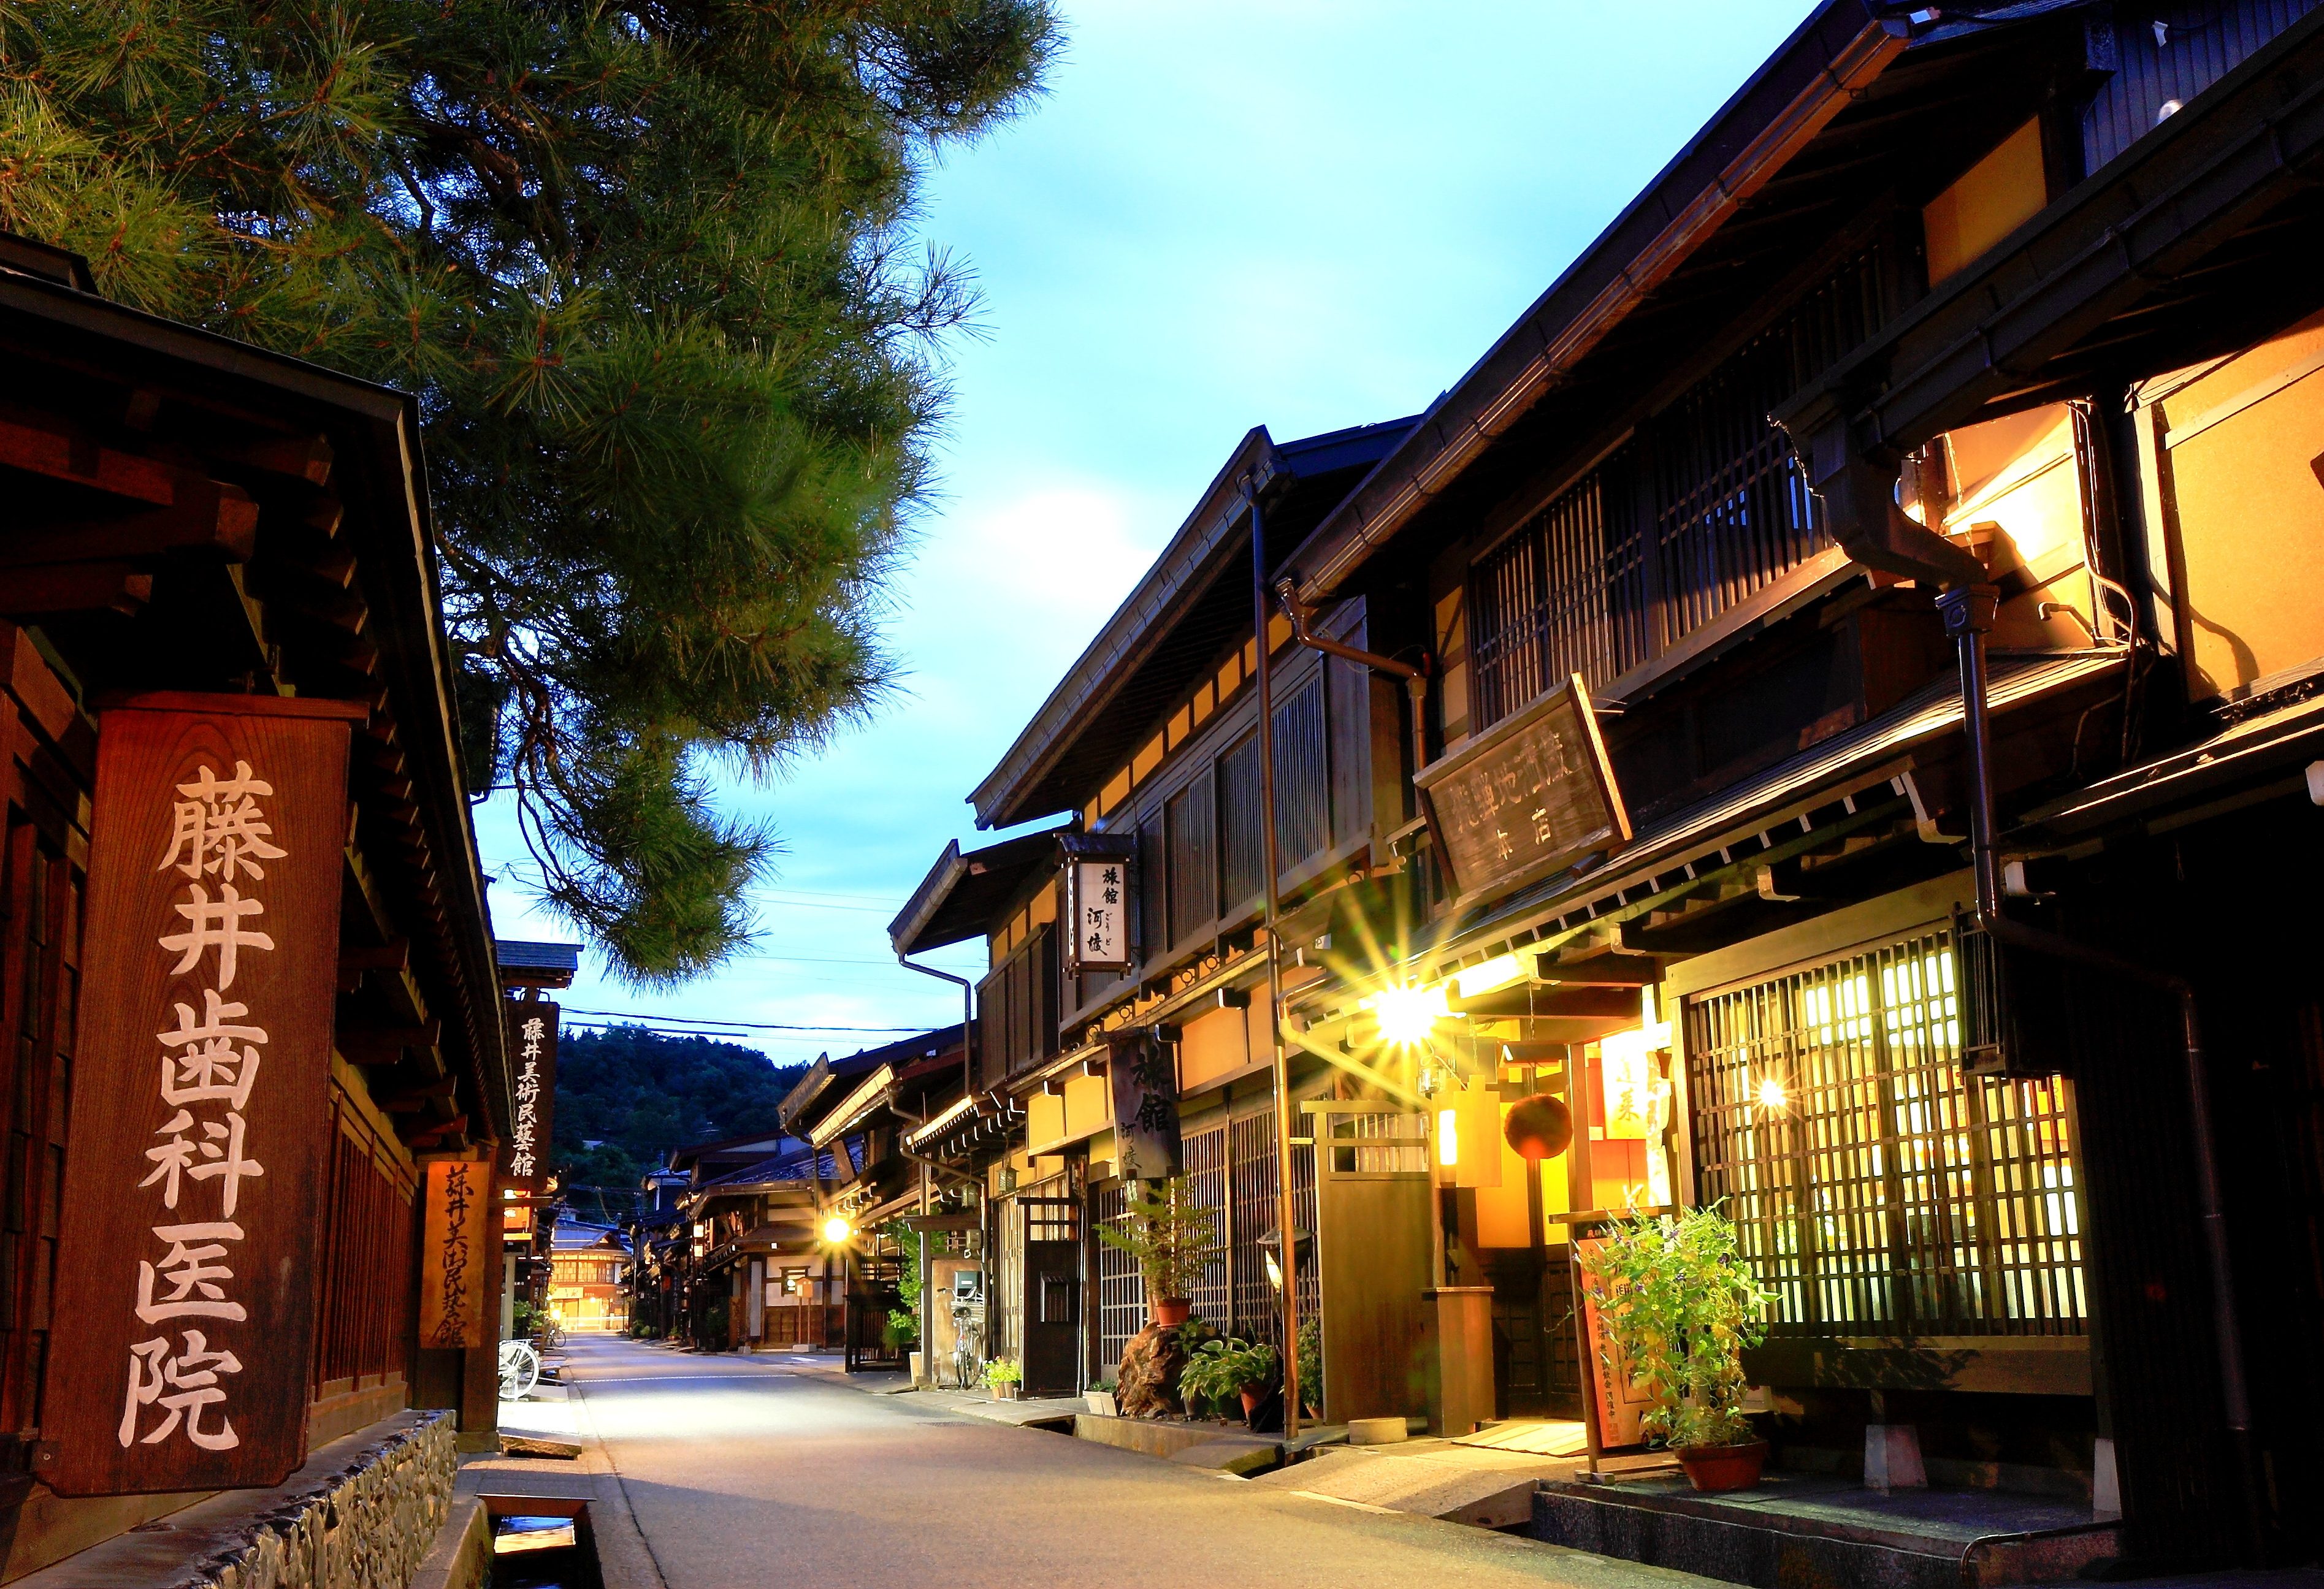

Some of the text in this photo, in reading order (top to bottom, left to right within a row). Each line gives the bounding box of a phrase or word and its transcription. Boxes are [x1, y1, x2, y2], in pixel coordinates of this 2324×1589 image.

[1102, 866, 1120, 905] 旅館
[1104, 912, 1113, 947] ごうど
[116, 760, 288, 1451] 藤井歯科医院
[510, 1016, 545, 1177] 藤井美術民藝館
[1130, 1044, 1172, 1134] 旅館
